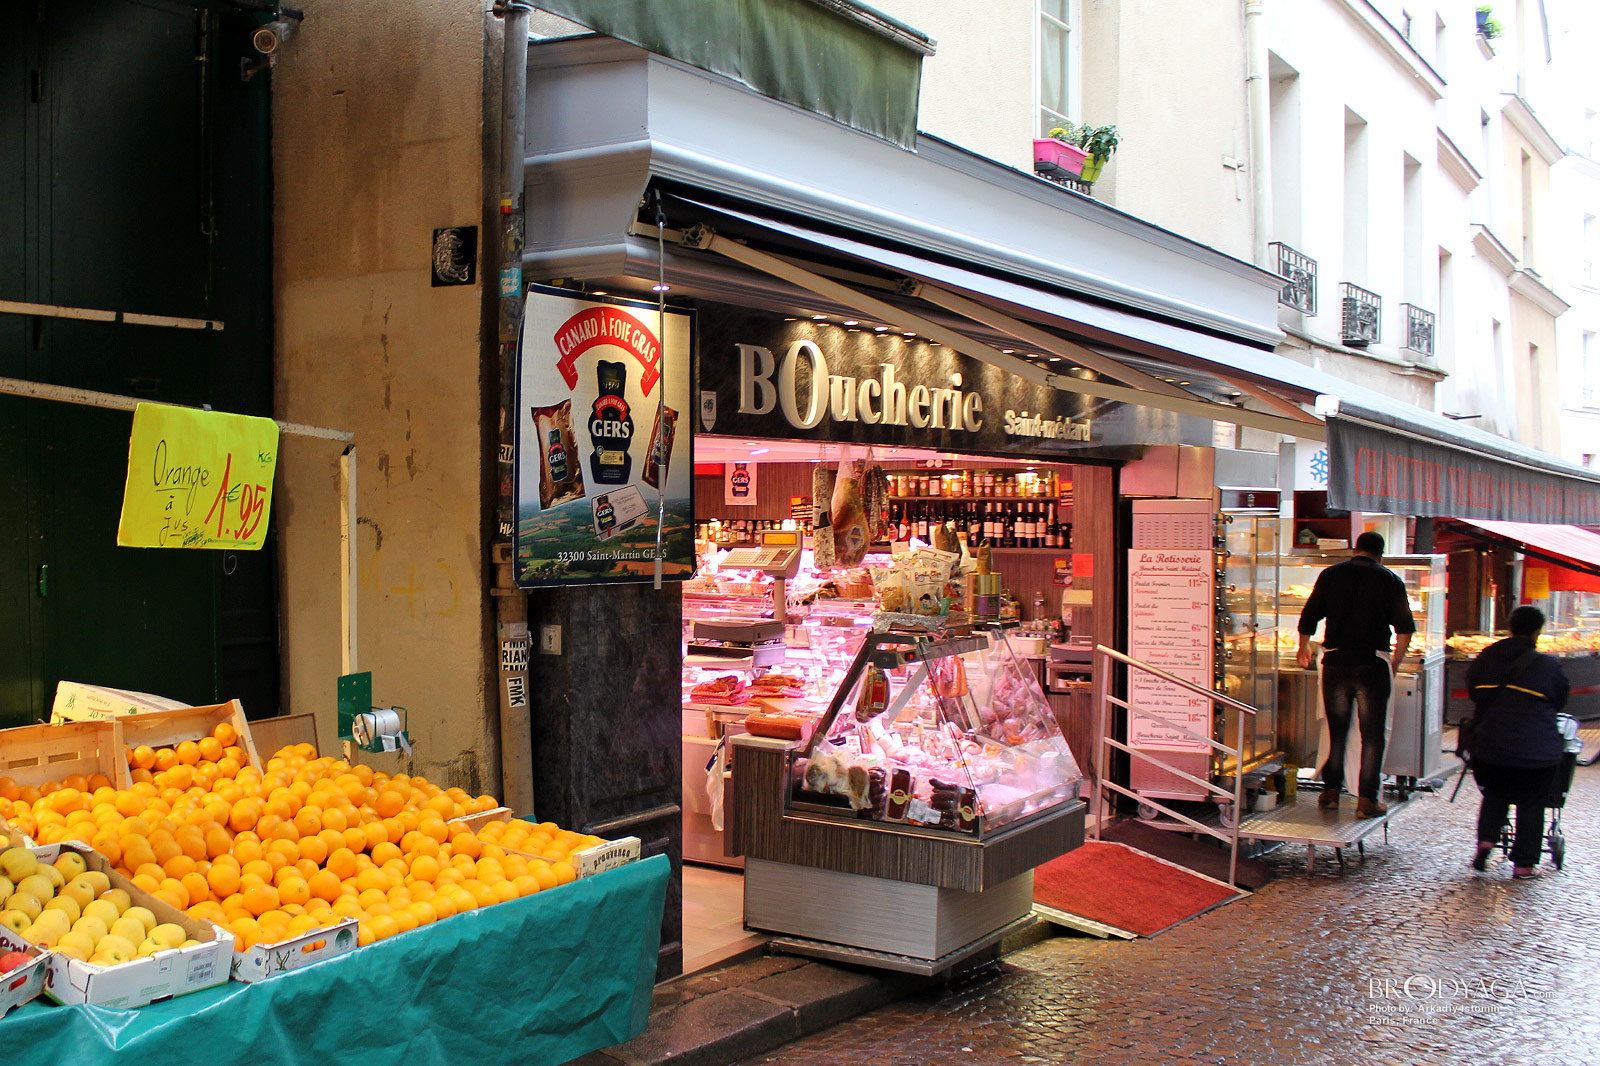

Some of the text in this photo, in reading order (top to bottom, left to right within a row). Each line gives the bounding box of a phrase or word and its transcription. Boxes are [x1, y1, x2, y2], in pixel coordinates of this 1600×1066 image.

[560, 310, 656, 362] CANARD À FOIE GRAS
[592, 420, 630, 438] GERS
[549, 454, 566, 464] GERS
[154, 440, 210, 516] Orange
[597, 507, 612, 517] GERS
[557, 549, 667, 562] 32300 Saint-Martin GES
[1139, 553, 1152, 562] La
